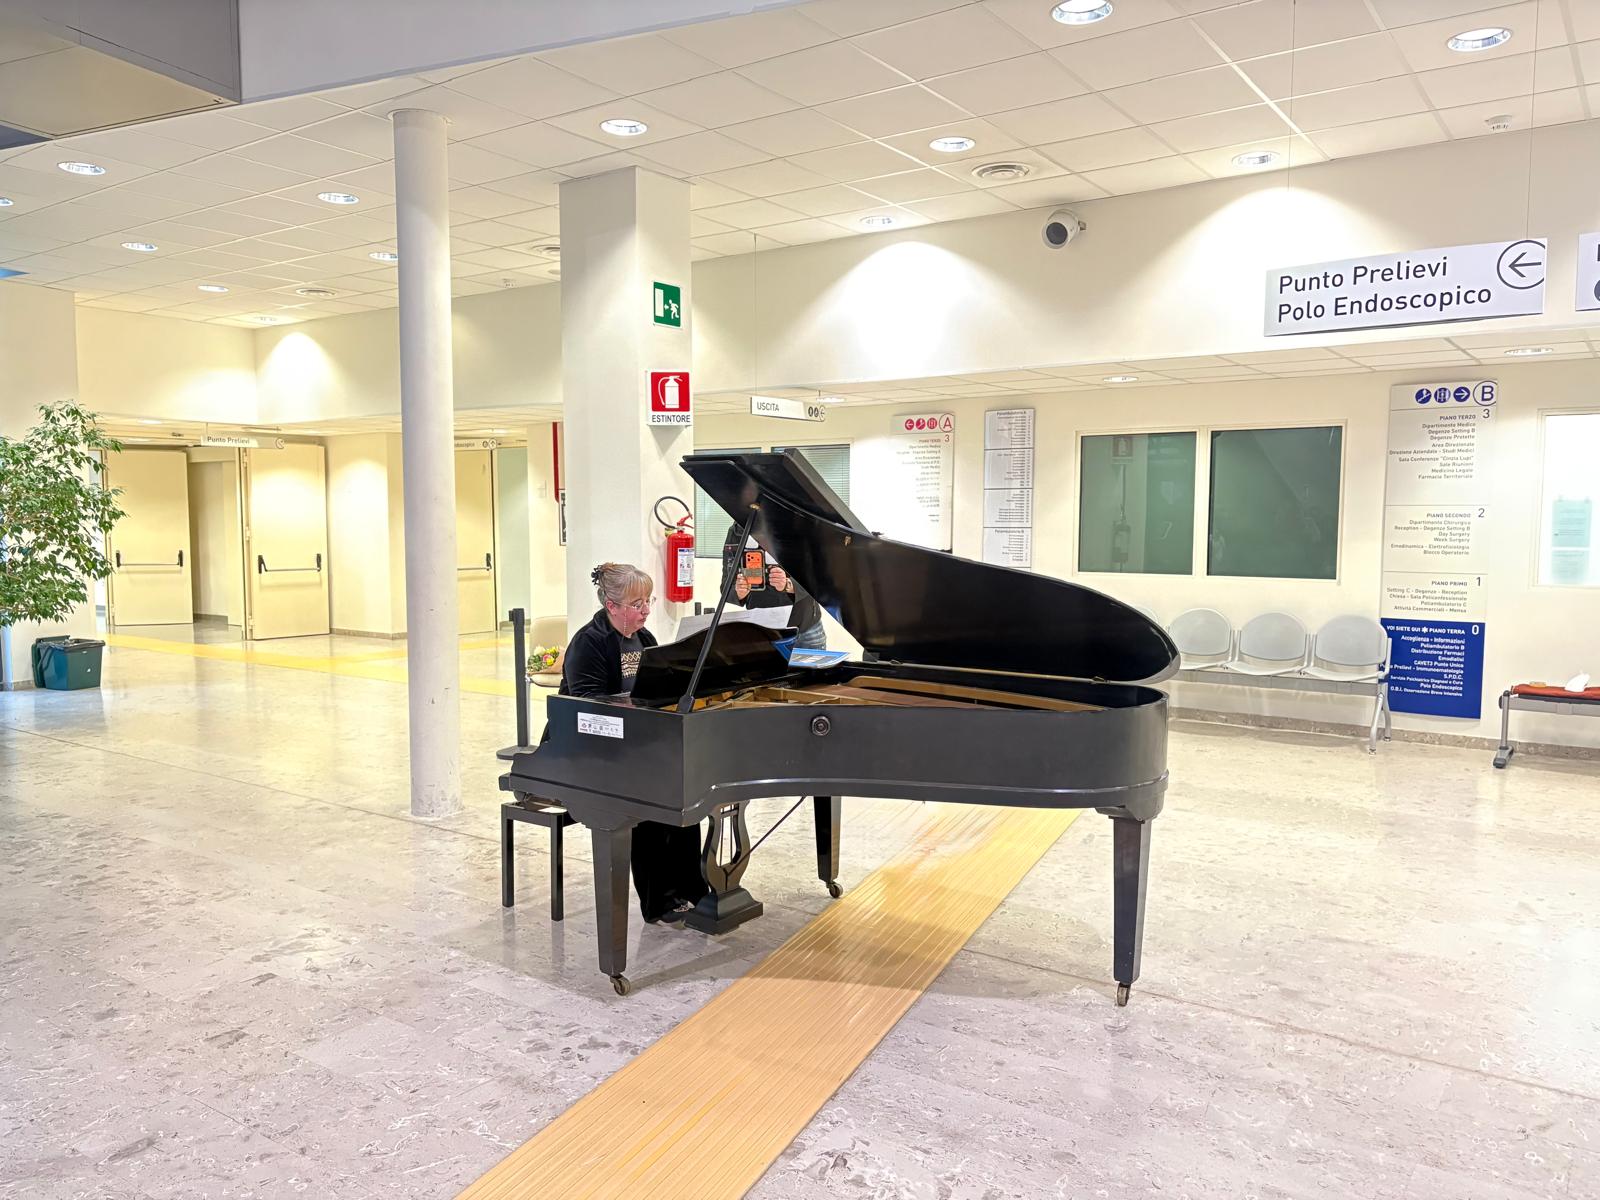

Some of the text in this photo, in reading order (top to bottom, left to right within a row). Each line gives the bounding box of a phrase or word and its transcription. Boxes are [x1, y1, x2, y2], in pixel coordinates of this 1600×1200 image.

[1280, 257, 1447, 294] Punto Prelievi
[1279, 286, 1491, 322] Polo Endoscopico
[1481, 386, 1494, 401] B
[757, 402, 779, 412] USCITA
[1482, 409, 1490, 418] 3
[943, 417, 952, 428] A
[1478, 508, 1485, 518] 2
[1476, 577, 1480, 586] 1
[1472, 625, 1479, 635] 0
